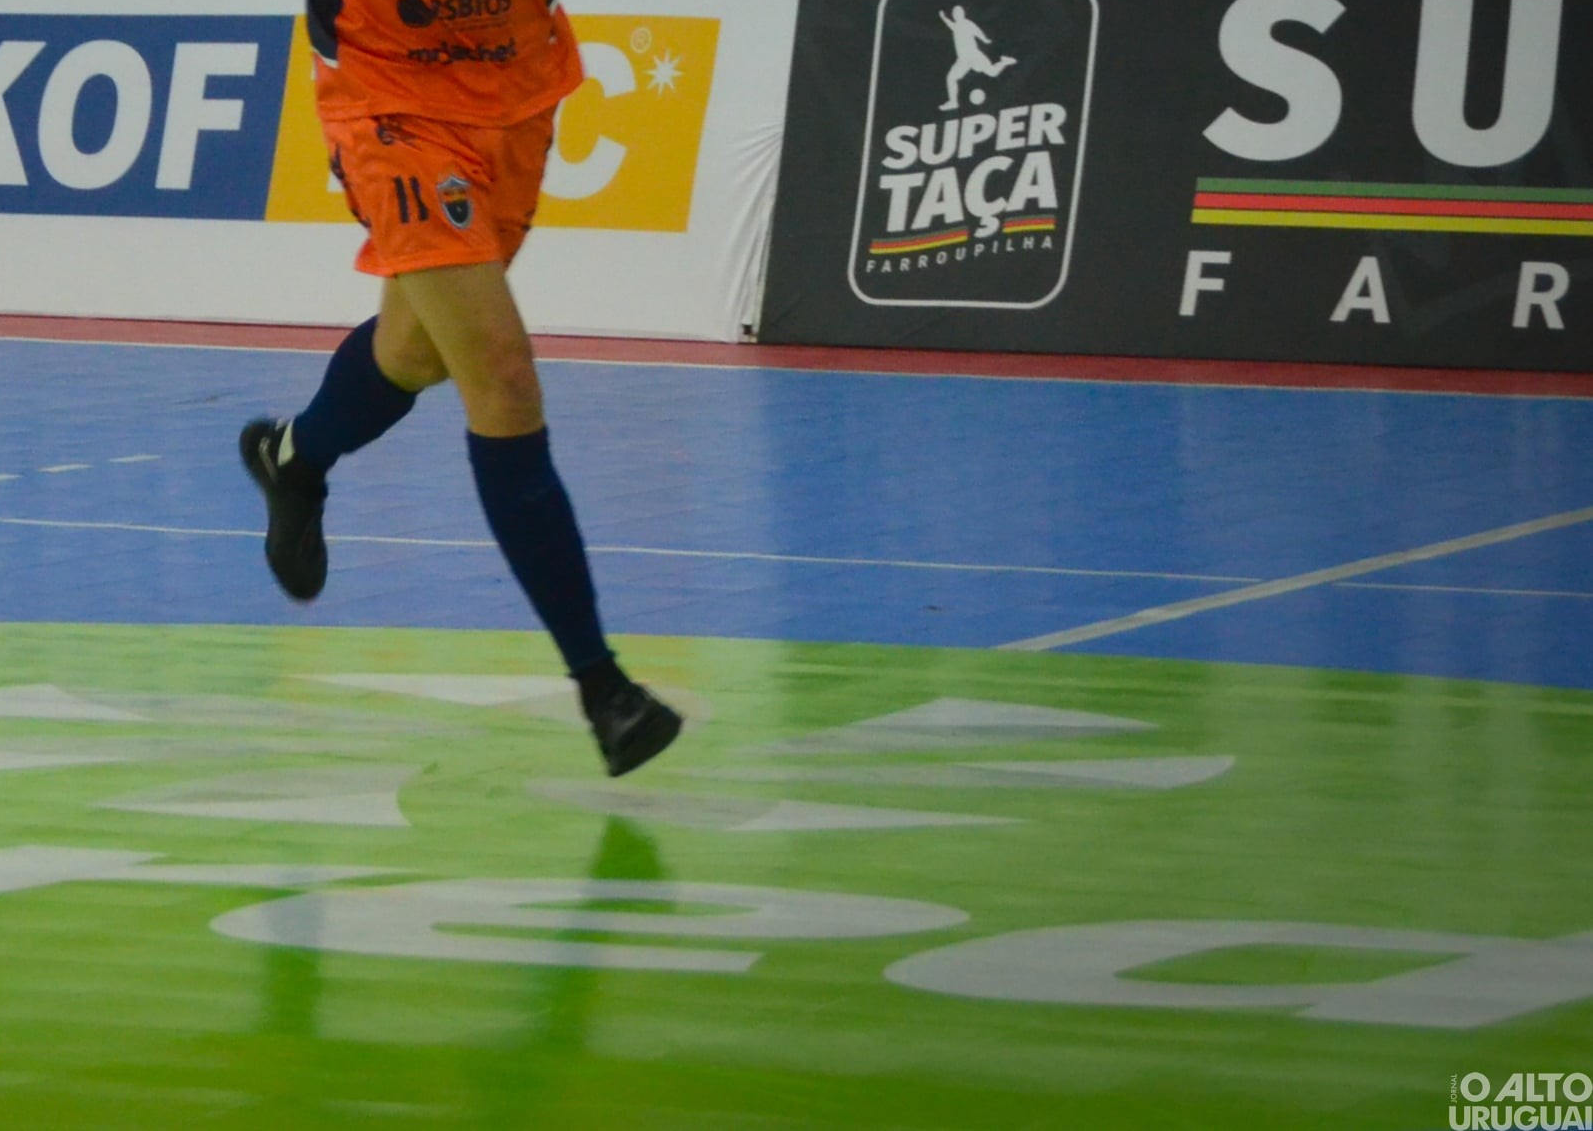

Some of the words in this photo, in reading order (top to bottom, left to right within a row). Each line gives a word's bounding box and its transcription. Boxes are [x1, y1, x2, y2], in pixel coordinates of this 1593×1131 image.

[881, 102, 1068, 170] SUPER
[393, 175, 430, 225] 11
[879, 150, 1059, 239] TAÇA
[865, 235, 1054, 273] FARROUPILHA
[1178, 249, 1570, 331] FAR
